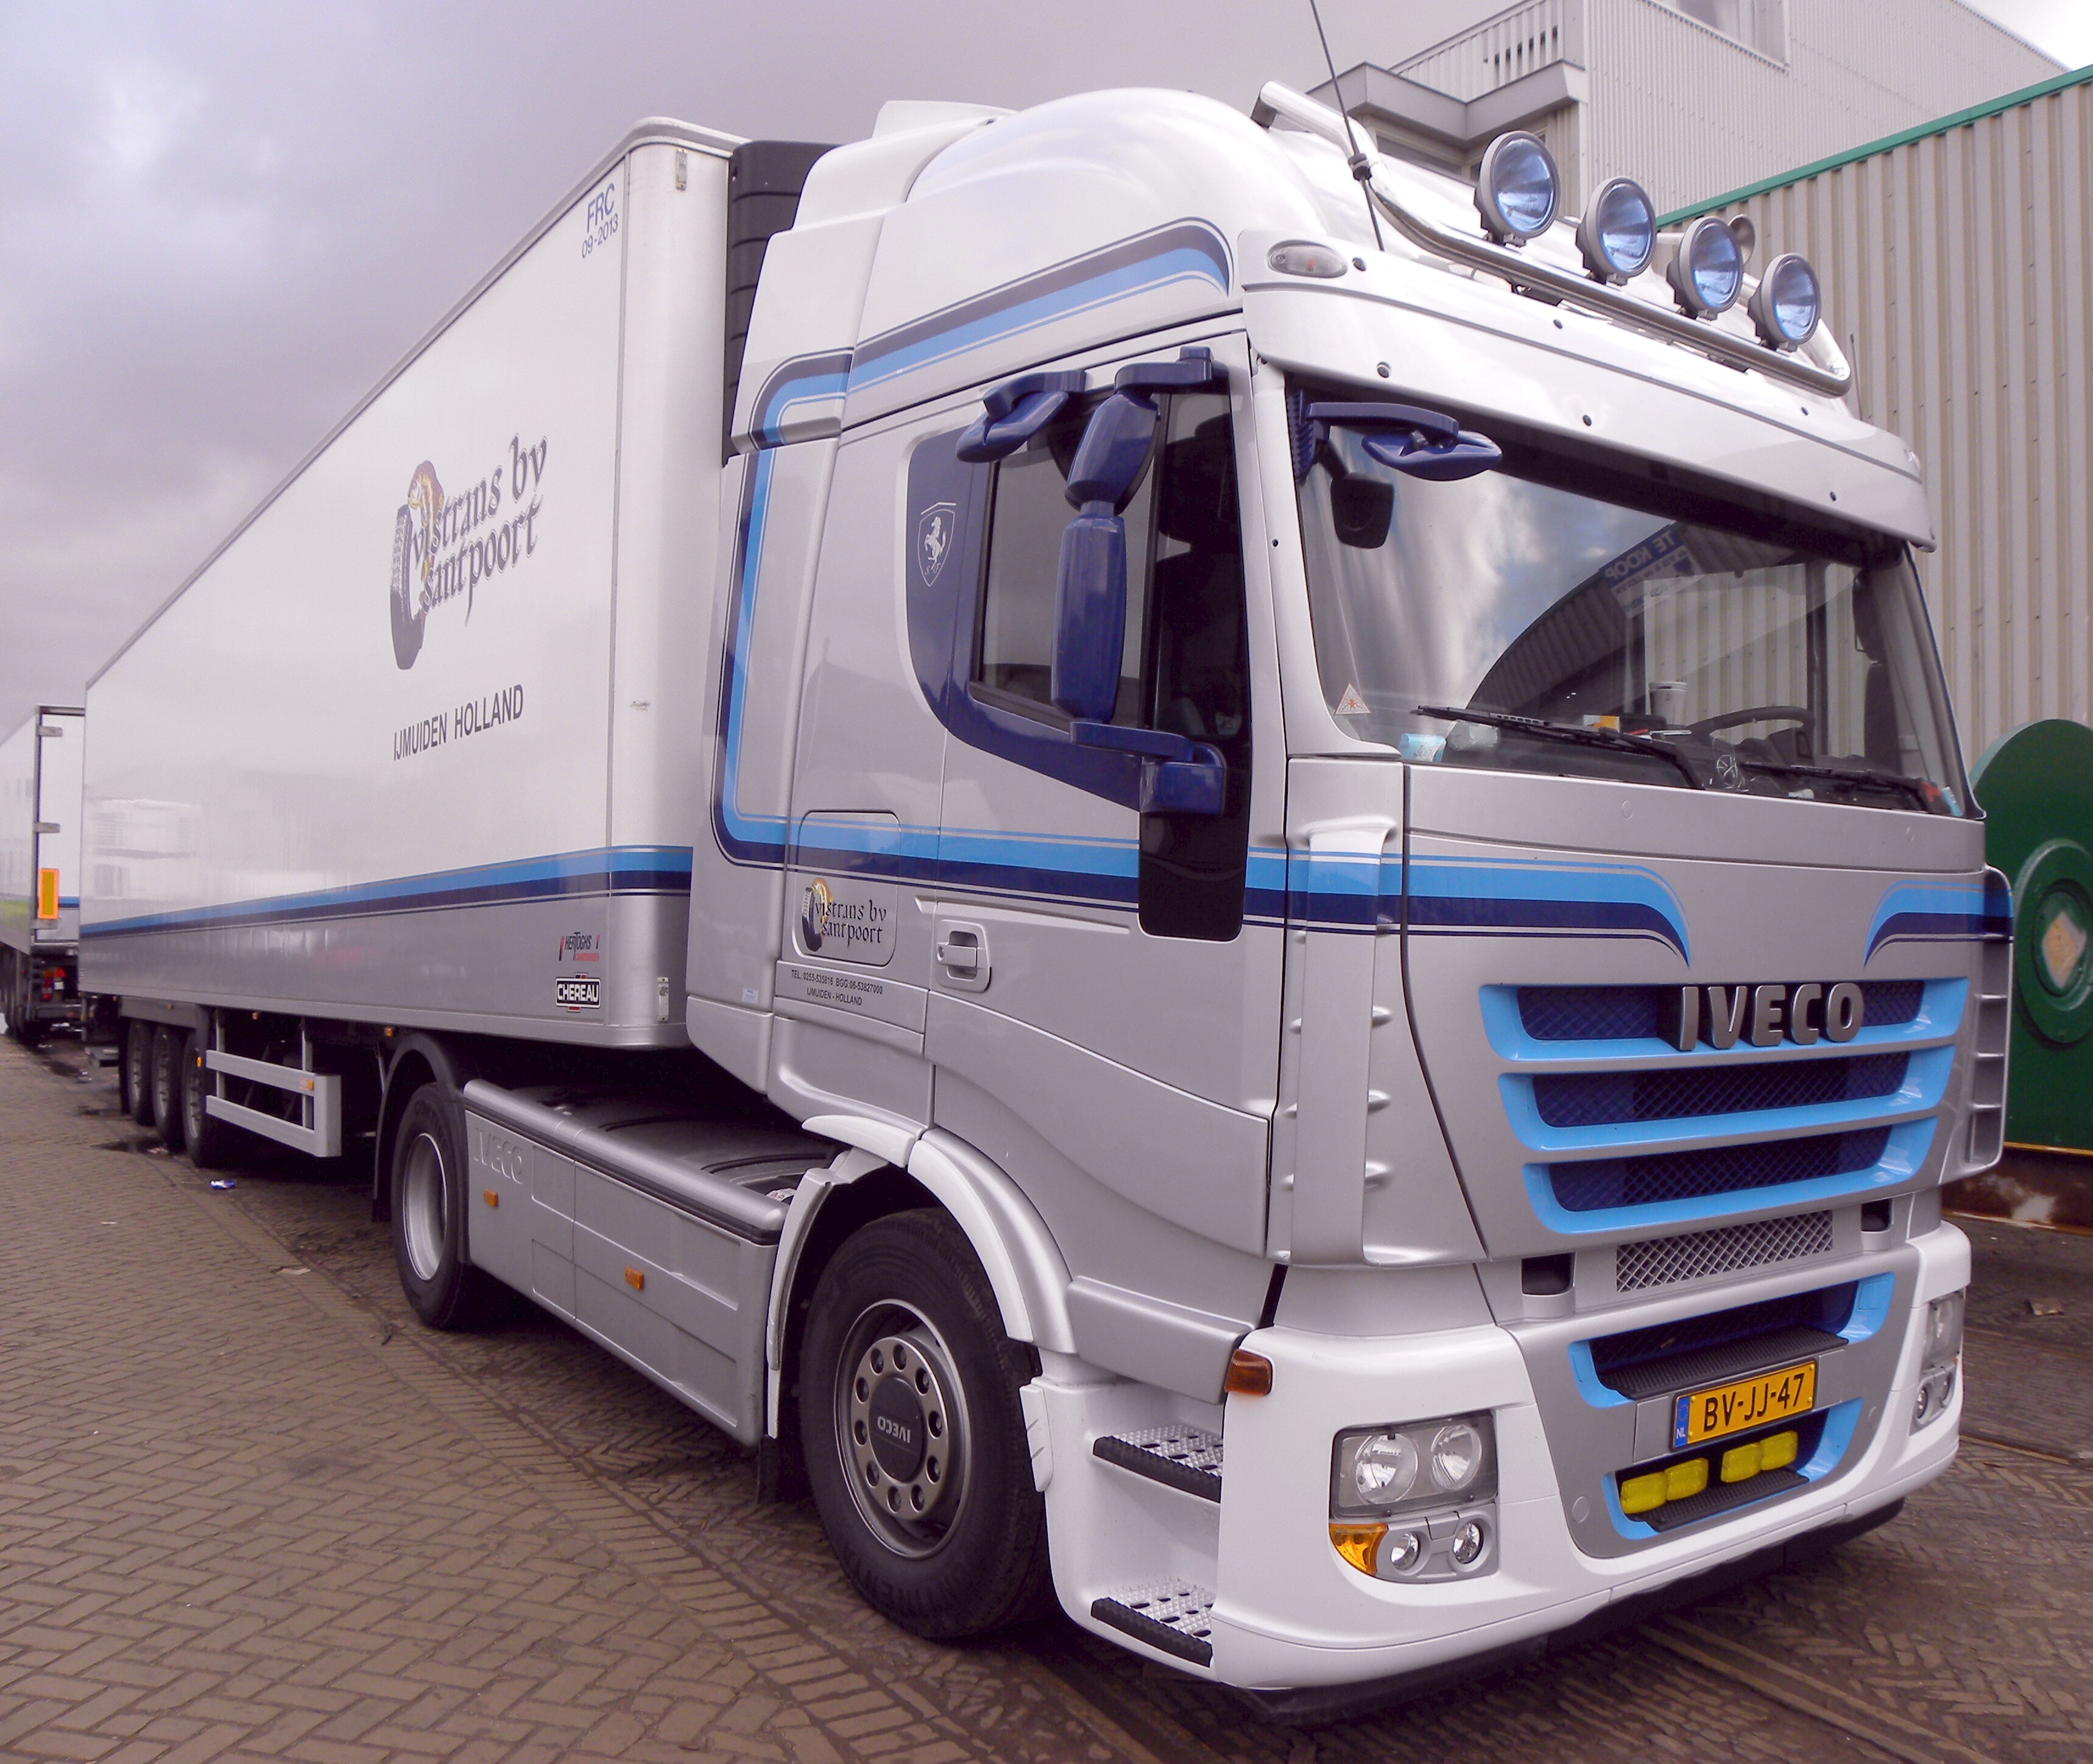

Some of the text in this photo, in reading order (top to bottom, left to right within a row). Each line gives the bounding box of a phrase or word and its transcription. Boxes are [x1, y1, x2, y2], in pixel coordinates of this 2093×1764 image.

[587, 182, 615, 233] FRC
[582, 213, 618, 258] 09-2013
[420, 493, 544, 627] santpoort
[394, 683, 524, 761] IJMUIDEN HOLLAND
[821, 921, 883, 948] santpoort
[557, 983, 599, 1003] CHEREAU
[836, 992, 863, 1006] HOLLAND
[1679, 982, 1865, 1051] IVECO
[1703, 1372, 1805, 1432] BV-JJ-47
[877, 1415, 911, 1444] IVECO
[1676, 1428, 1686, 1438] NL
